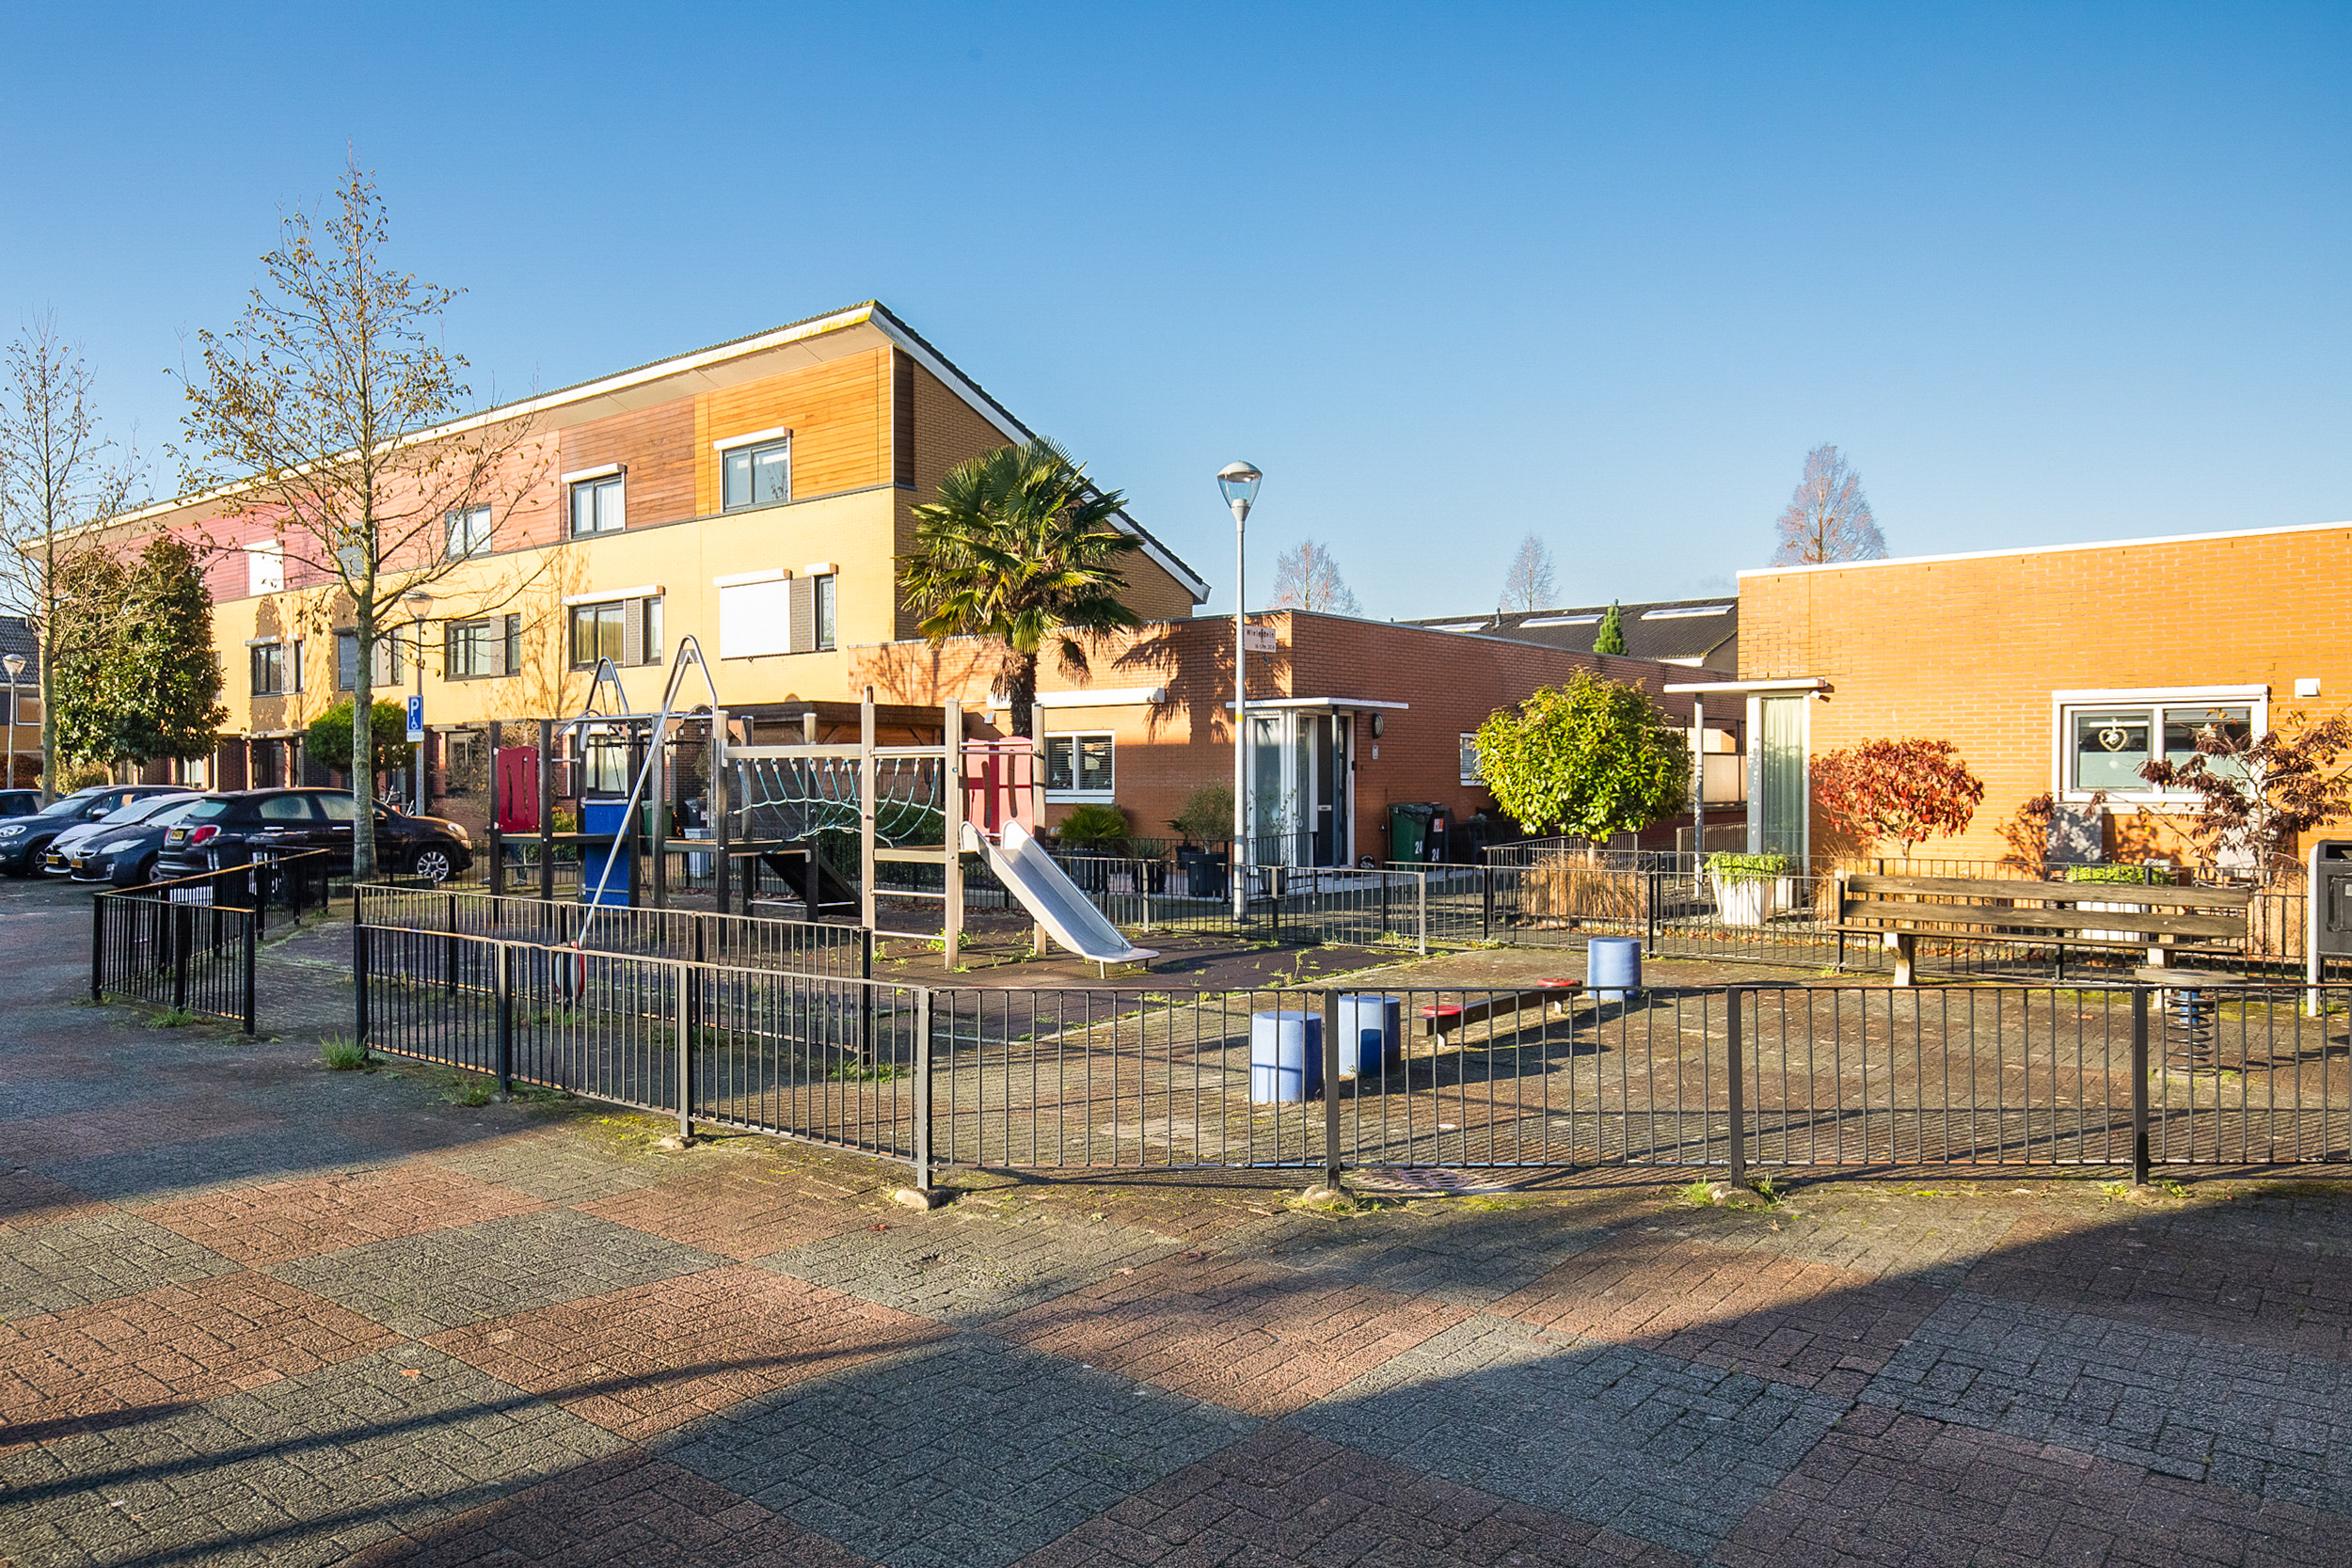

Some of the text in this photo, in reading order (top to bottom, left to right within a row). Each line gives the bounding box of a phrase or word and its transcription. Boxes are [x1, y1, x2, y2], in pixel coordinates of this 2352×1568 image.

[410, 698, 420, 717] P
[1415, 841, 1422, 854] 24
[1432, 848, 1439, 862] 24
